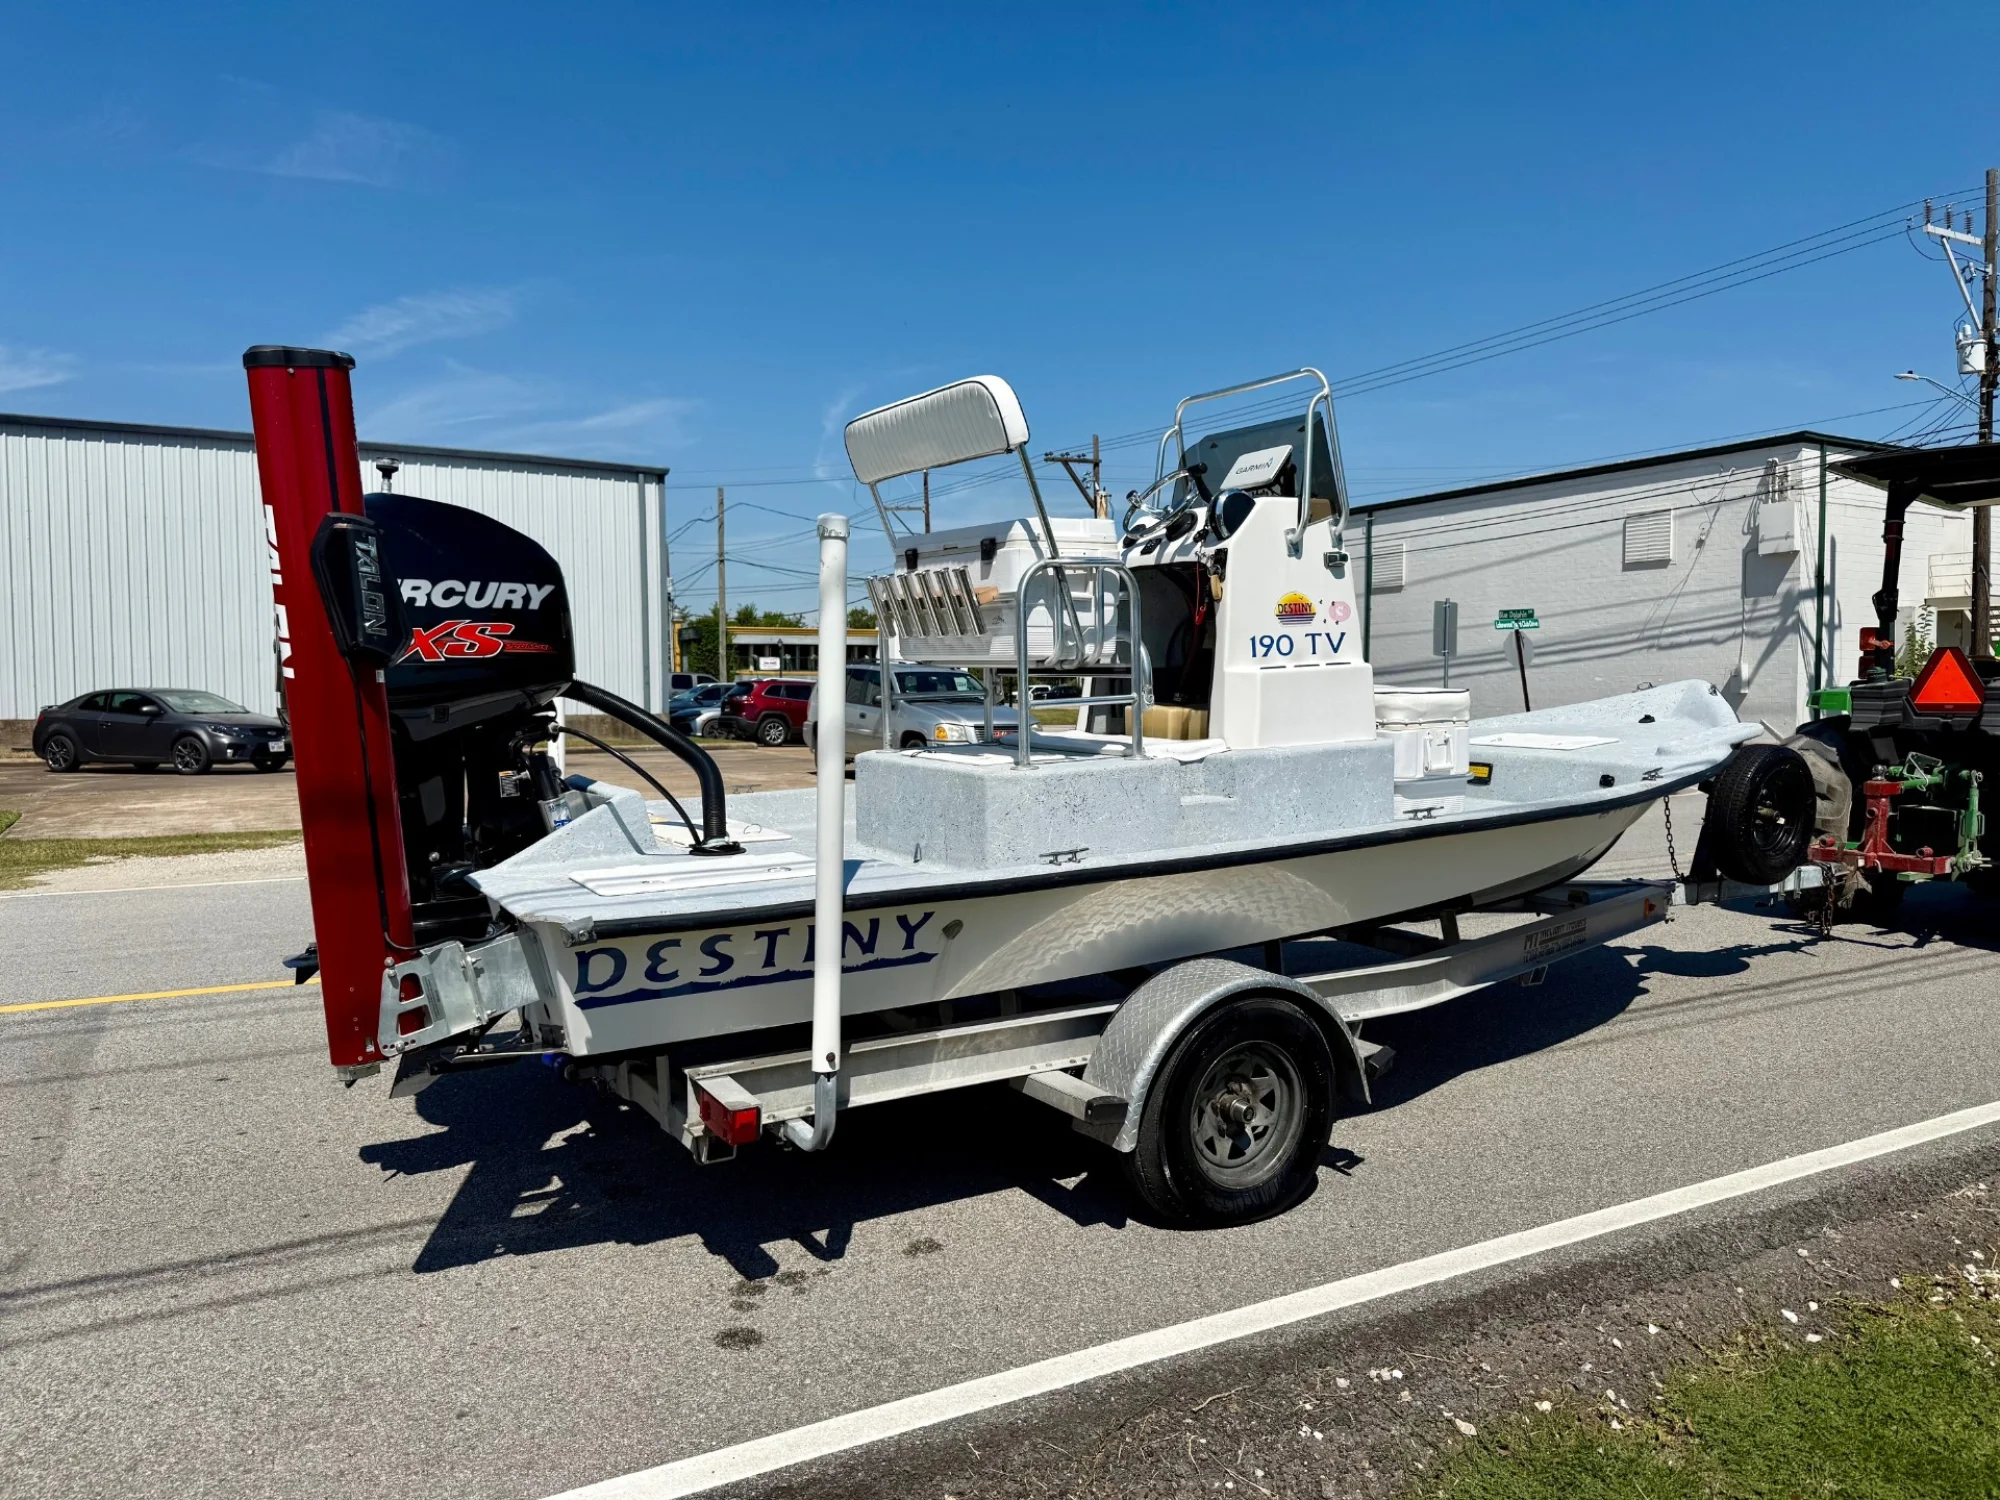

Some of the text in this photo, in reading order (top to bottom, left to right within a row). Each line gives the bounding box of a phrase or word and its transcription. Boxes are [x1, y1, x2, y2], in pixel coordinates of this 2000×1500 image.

[1235, 461, 1273, 475] GARMIN
[355, 535, 388, 637] TALON
[398, 578, 555, 610] RCURY
[1277, 602, 1313, 614] DESTINY
[396, 619, 515, 662] XS
[1250, 632, 1346, 658] 190 TV
[574, 911, 935, 995] DESTINY
